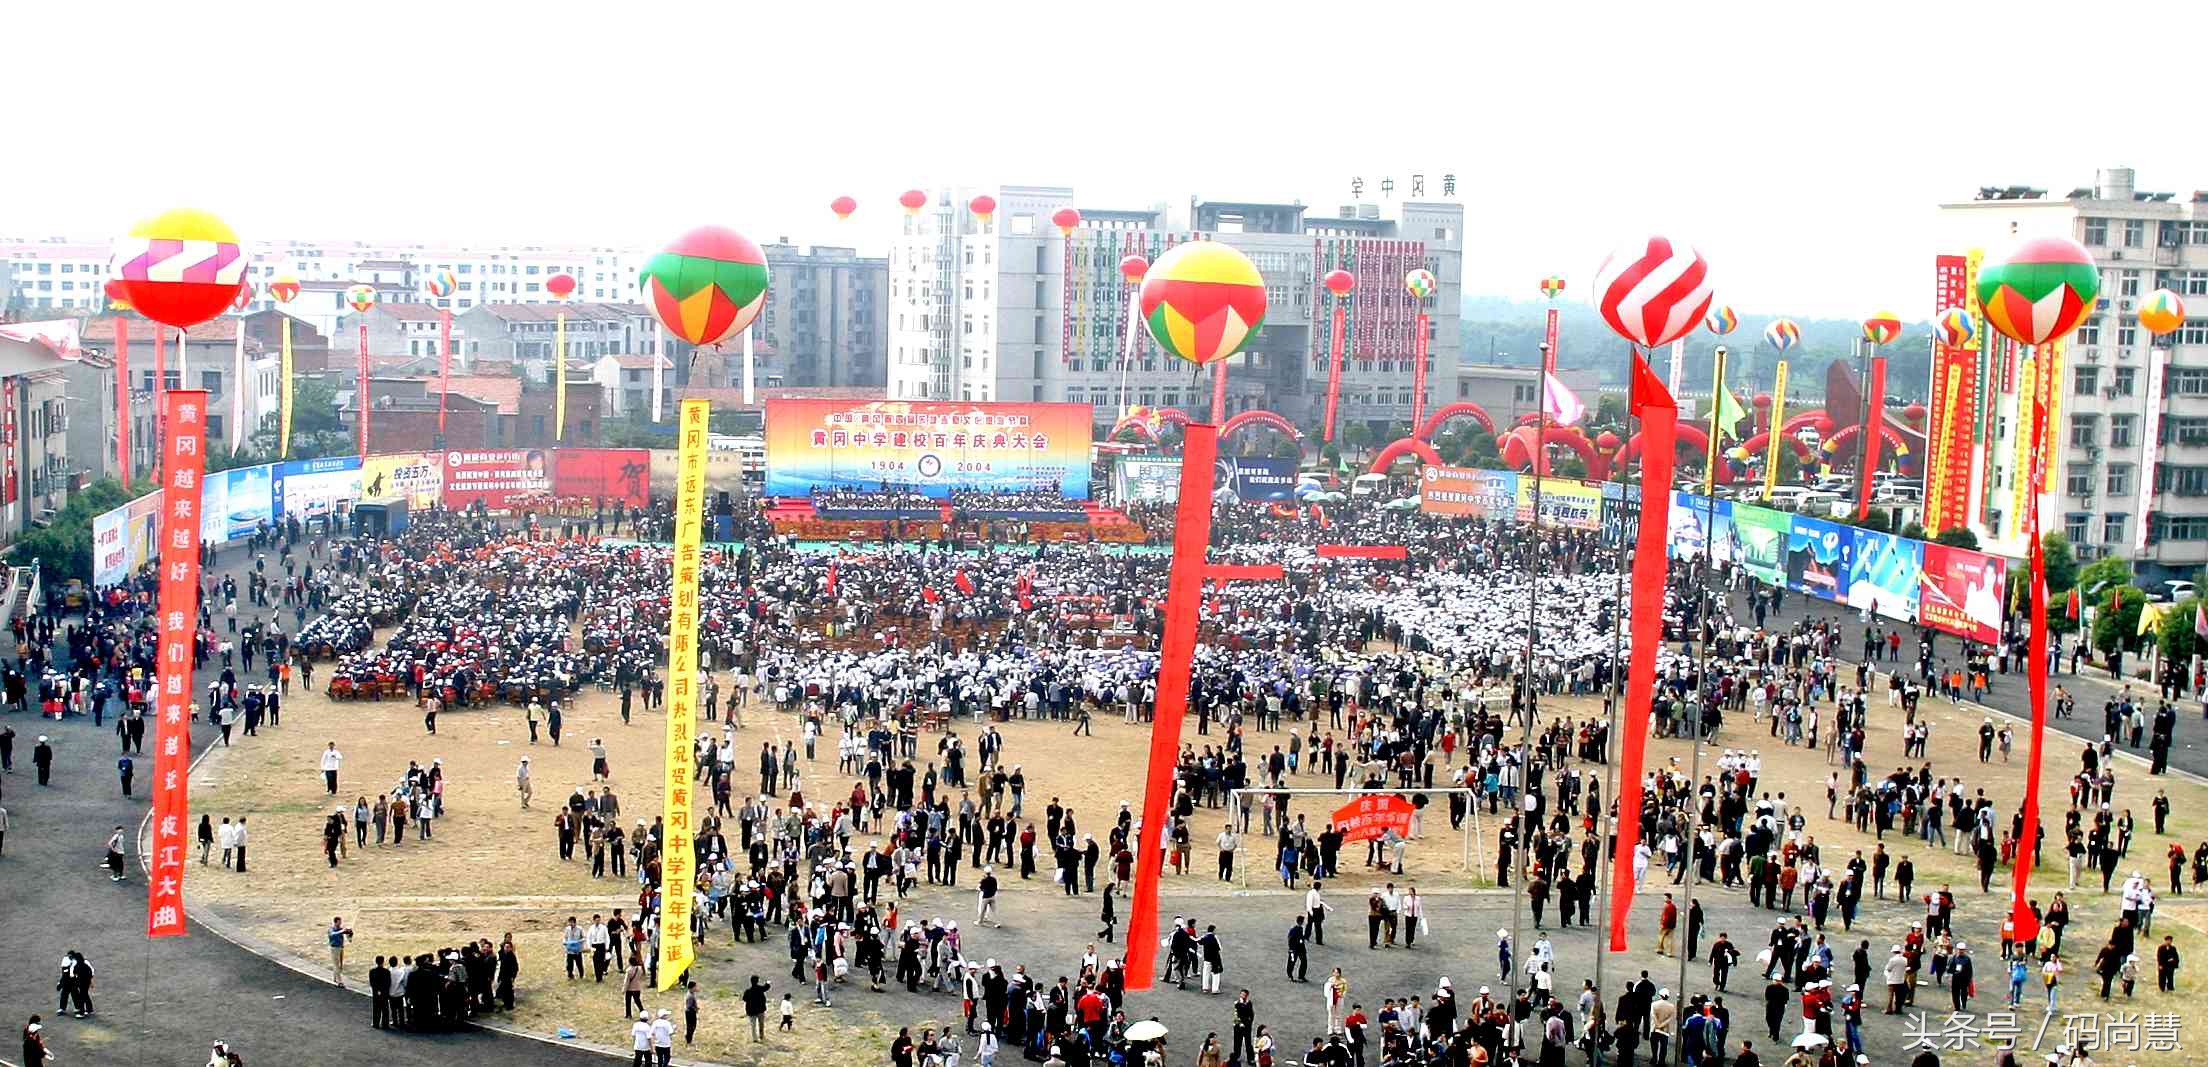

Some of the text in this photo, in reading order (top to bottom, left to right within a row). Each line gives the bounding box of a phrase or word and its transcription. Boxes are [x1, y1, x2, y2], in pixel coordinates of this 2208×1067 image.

[813, 431, 1047, 448] 黄冈中学建校百年庆典大会
[871, 461, 991, 472] 1904 2004
[170, 403, 197, 581] 黄冈越来越好
[153, 816, 180, 929] 枝江大曲
